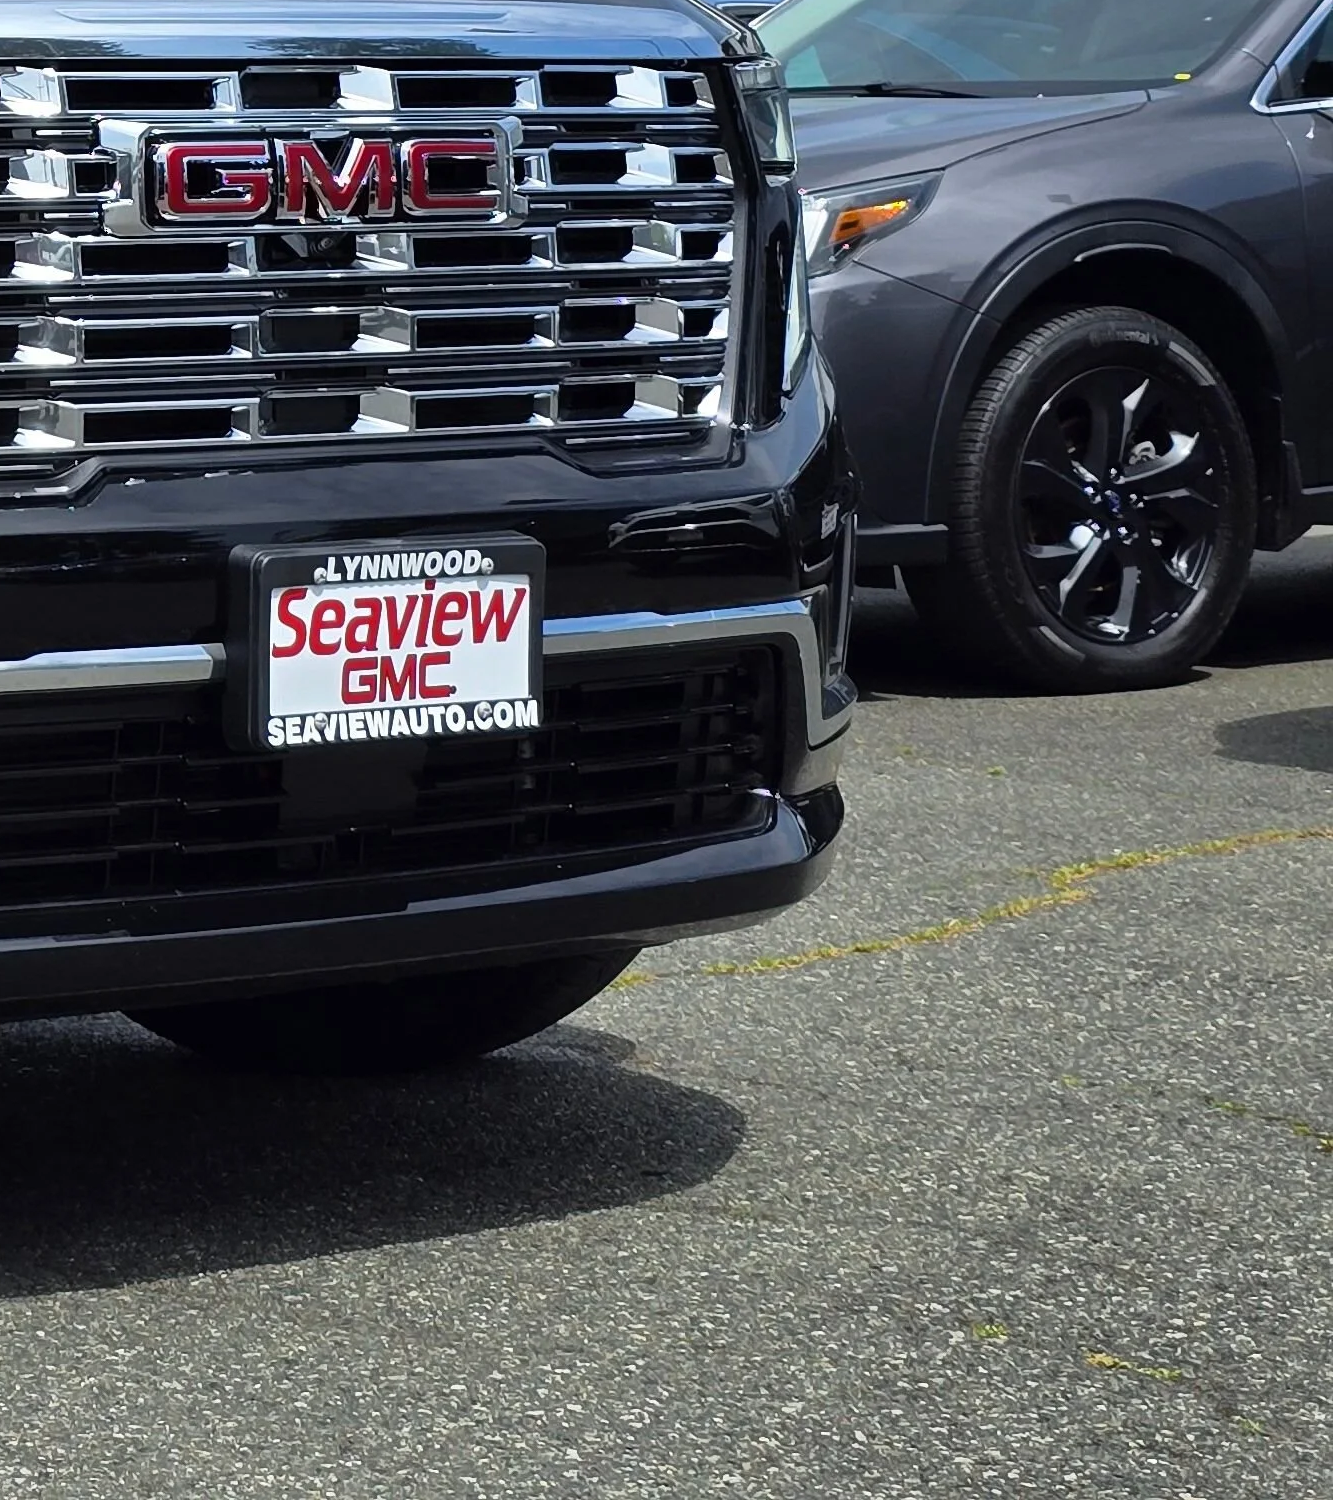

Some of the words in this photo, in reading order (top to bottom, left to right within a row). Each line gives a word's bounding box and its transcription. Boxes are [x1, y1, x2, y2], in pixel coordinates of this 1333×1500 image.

[156, 137, 503, 222] GMC
[326, 550, 482, 581] LYNNWOOD
[271, 579, 527, 658] Seaview
[341, 651, 452, 705] GMC
[267, 699, 539, 747] SEAVIEWAUTO.COM
